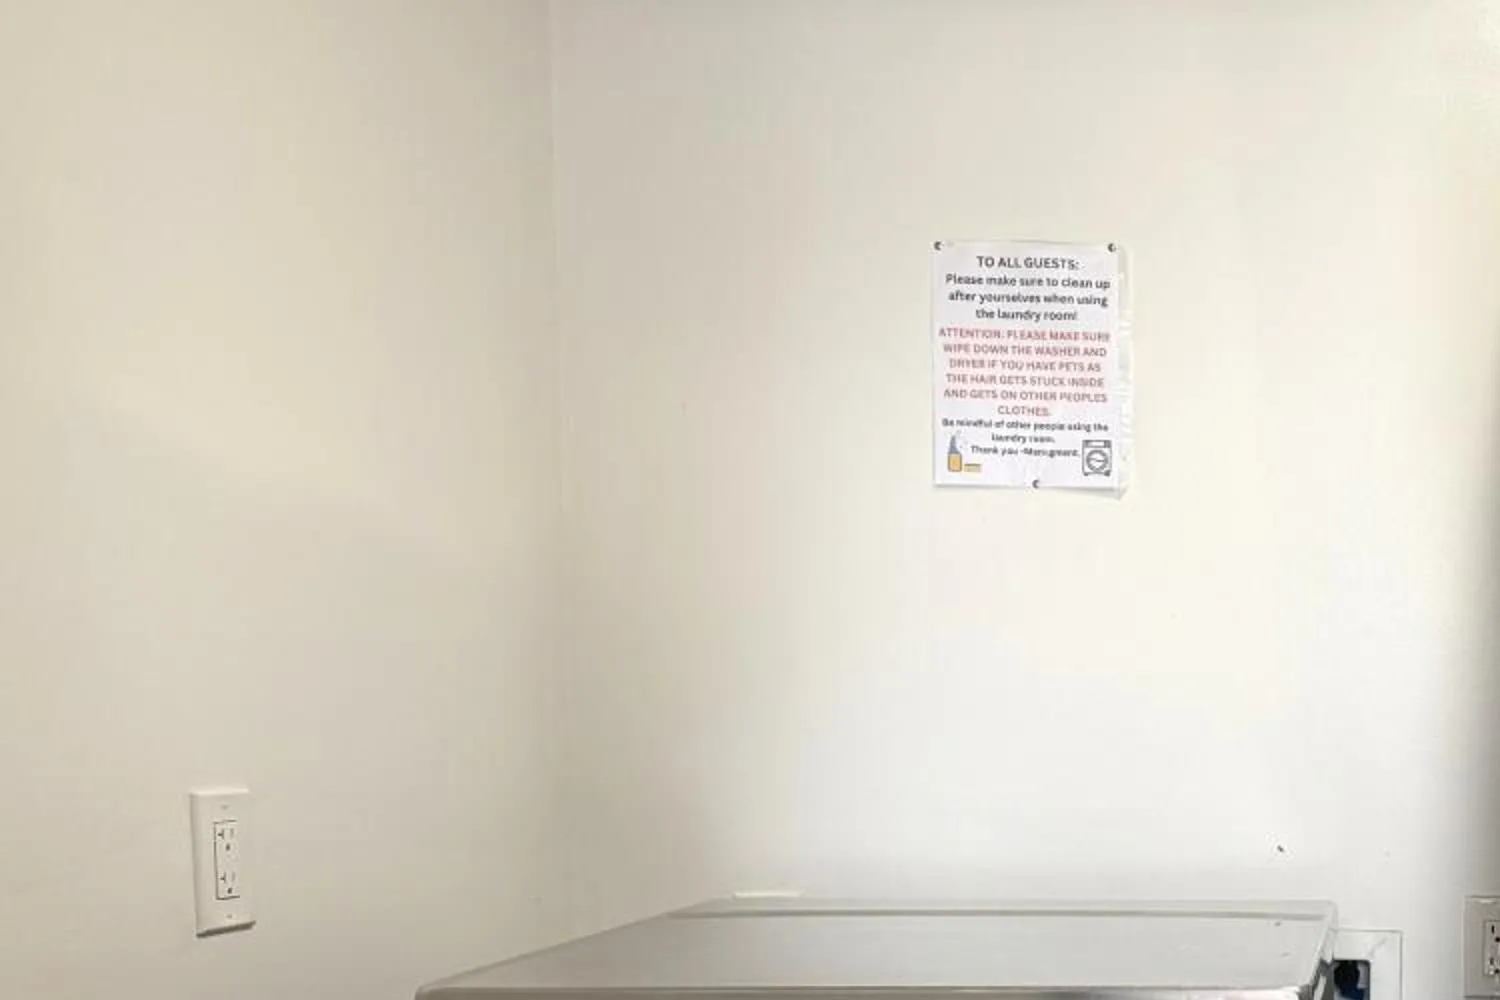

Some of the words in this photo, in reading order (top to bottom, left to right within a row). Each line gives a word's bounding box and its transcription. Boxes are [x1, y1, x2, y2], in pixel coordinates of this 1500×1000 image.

[976, 255, 995, 269] TO
[998, 256, 1022, 269] ALL
[1024, 256, 1080, 271] GUESTS:
[945, 273, 984, 286] Please
[986, 275, 1017, 287] make
[1019, 277, 1044, 287] sure
[1046, 276, 1059, 287] to
[1061, 277, 1093, 289] clean
[1095, 280, 1111, 292] up
[948, 289, 977, 301] after
[979, 291, 1041, 304] yourselves
[1043, 292, 1075, 303] when
[1076, 294, 1109, 307] using
[975, 308, 995, 319] the
[997, 309, 1042, 323] laundry
[1007, 329, 1047, 341] PLEASE
[1049, 331, 1080, 341] MAKE
[1082, 331, 1111, 343] SURE
[943, 343, 970, 353] WIPE
[973, 344, 1009, 354] DOWN
[1011, 345, 1033, 355] THE
[1035, 346, 1080, 357] WASHER
[1083, 347, 1107, 358] AND
[949, 358, 985, 369] DRYER
[987, 359, 997, 369] IF
[1000, 360, 1024, 371] YOU
[1026, 361, 1056, 371] HAVE
[1058, 361, 1084, 372] PETS
[1087, 362, 1101, 372] AS
[945, 373, 968, 383] THE
[970, 374, 997, 384] HAIR
[999, 375, 1028, 386] GETS
[1030, 376, 1066, 387] STUCK
[1067, 377, 1105, 388] INSIDE
[944, 389, 967, 399] AND
[969, 390, 998, 399] GETS
[1000, 390, 1017, 400] ON
[1019, 391, 1057, 401] OTHER
[1059, 392, 1108, 403] PEOPLES
